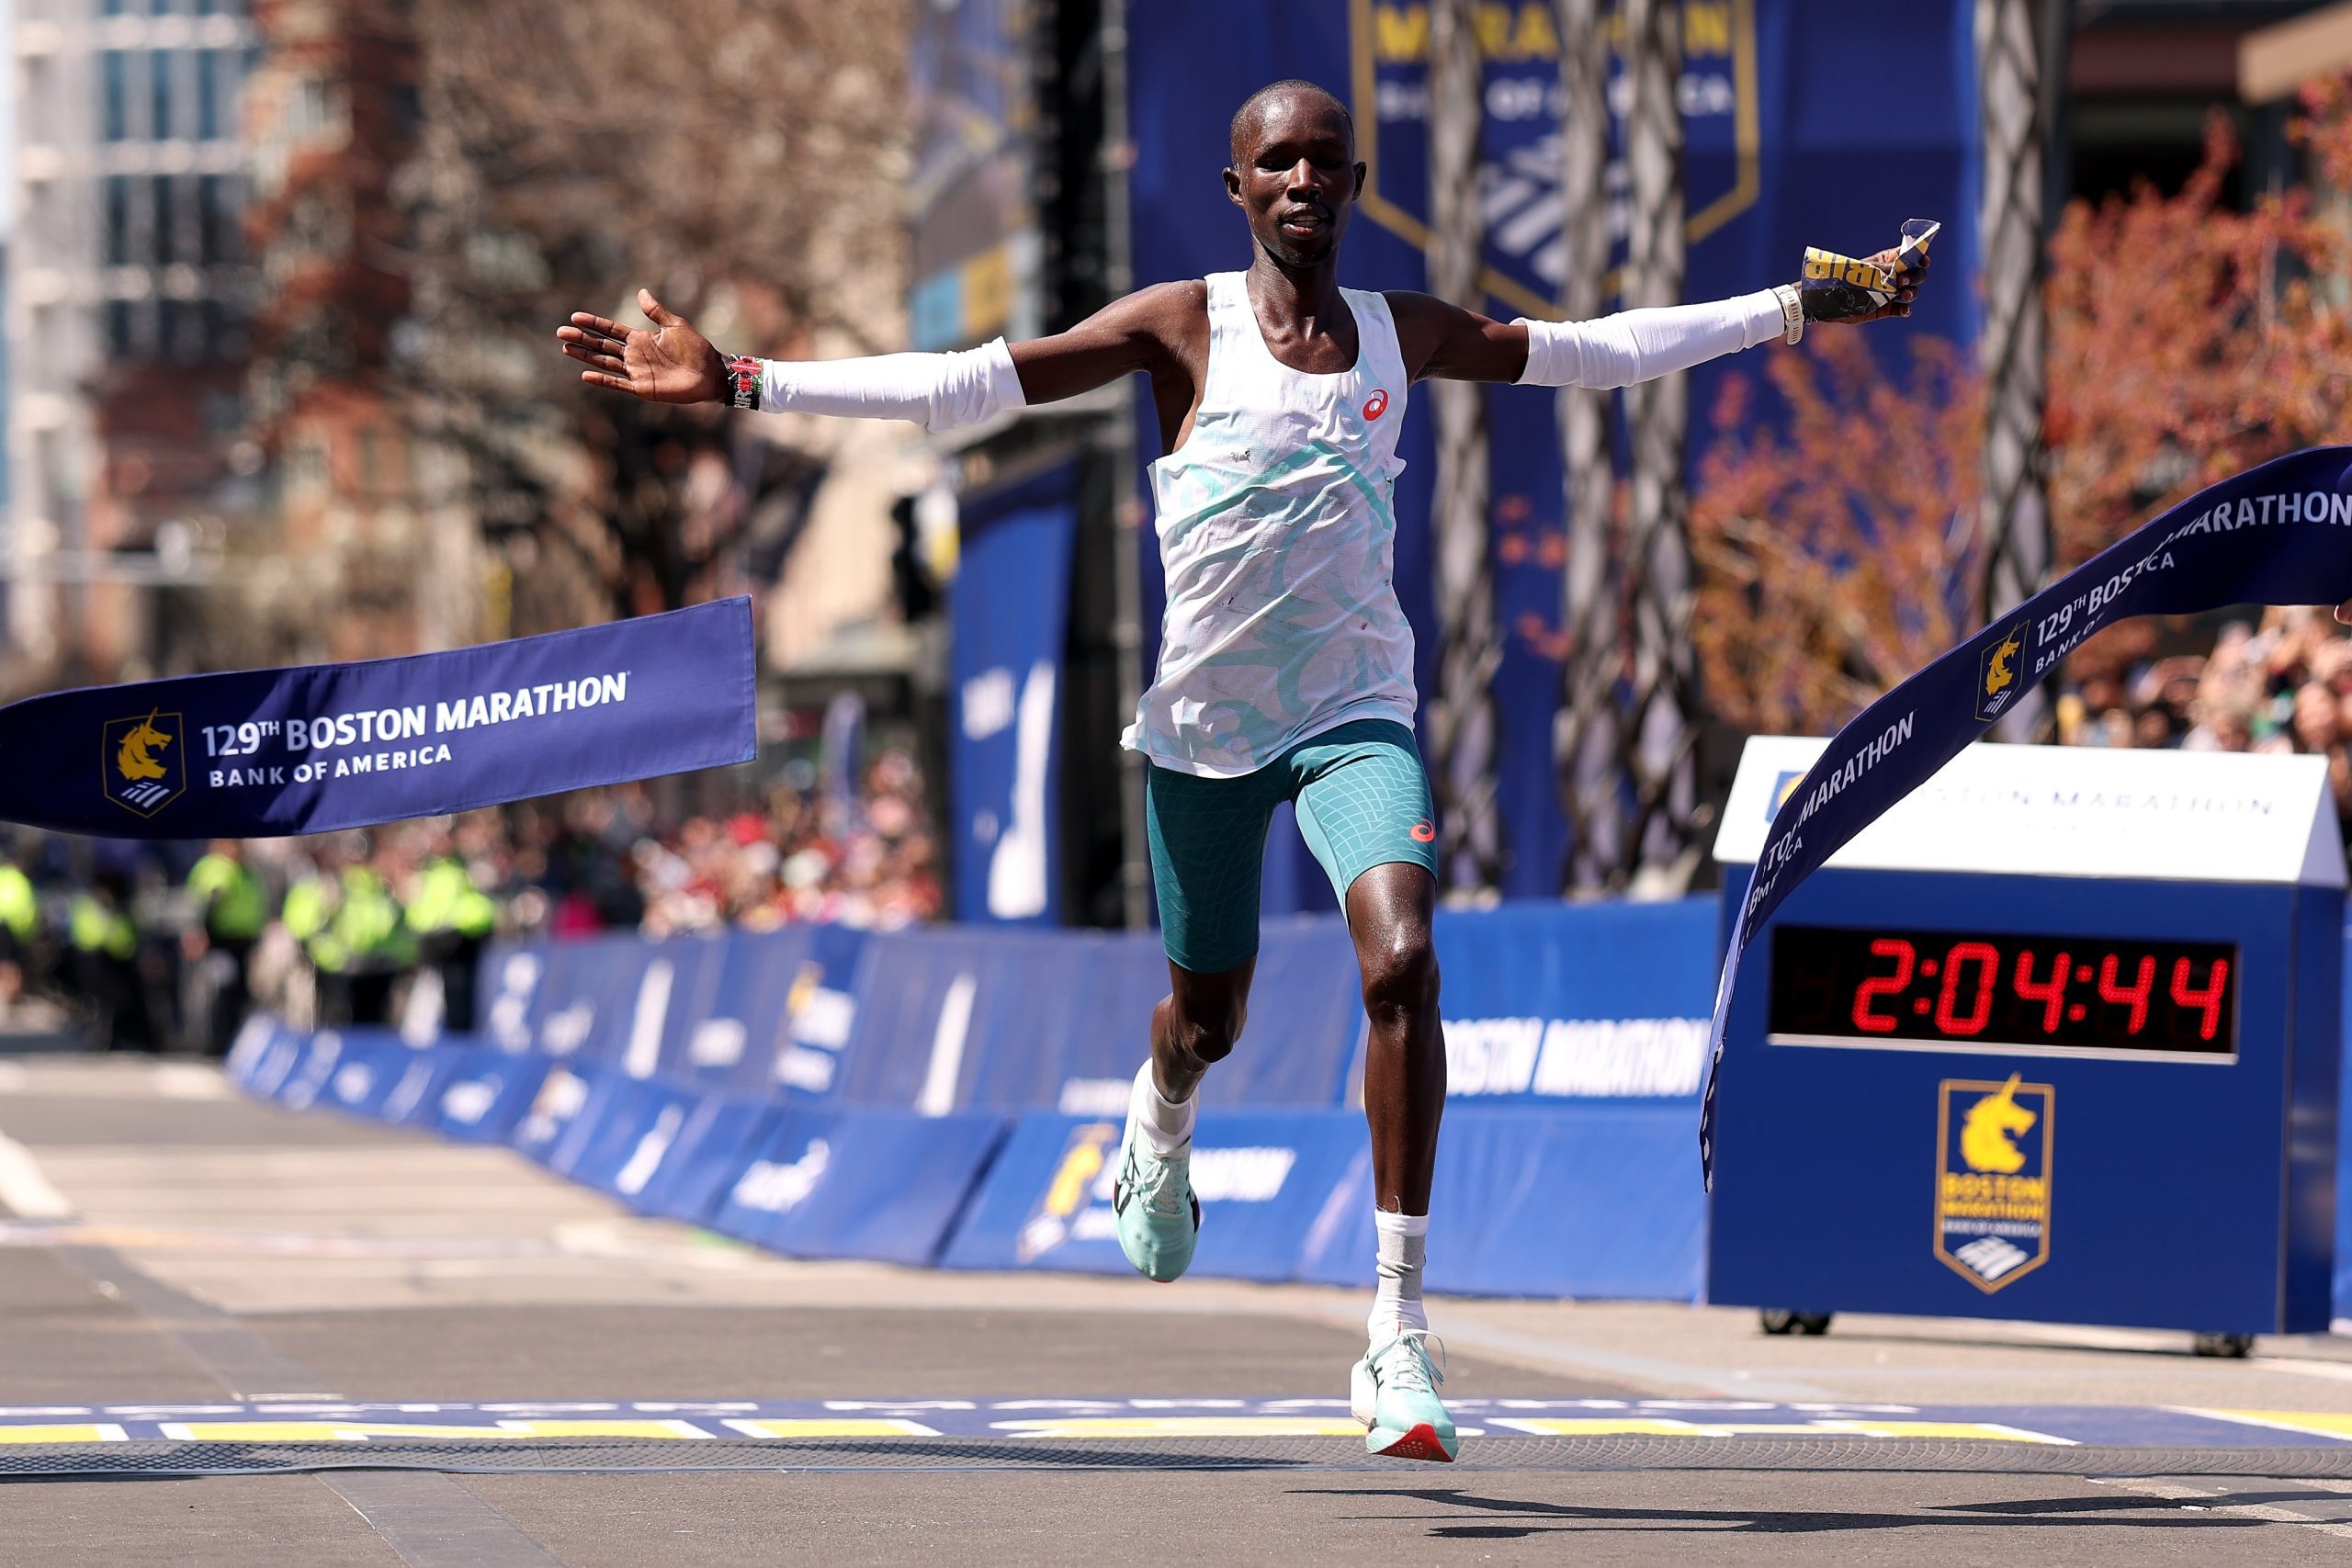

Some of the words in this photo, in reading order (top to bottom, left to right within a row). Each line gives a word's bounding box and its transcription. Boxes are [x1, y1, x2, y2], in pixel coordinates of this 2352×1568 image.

[2037, 593, 2086, 648] 129TH
[201, 720, 280, 757] 129TH
[287, 705, 426, 751] BOSTON
[435, 671, 627, 734] MARATHON
[209, 765, 286, 788] BANK
[293, 761, 329, 784] OF
[334, 743, 452, 778] AMERICA
[1797, 710, 1915, 829] MARATHON
[1851, 938, 2230, 1041] 2:04:44
